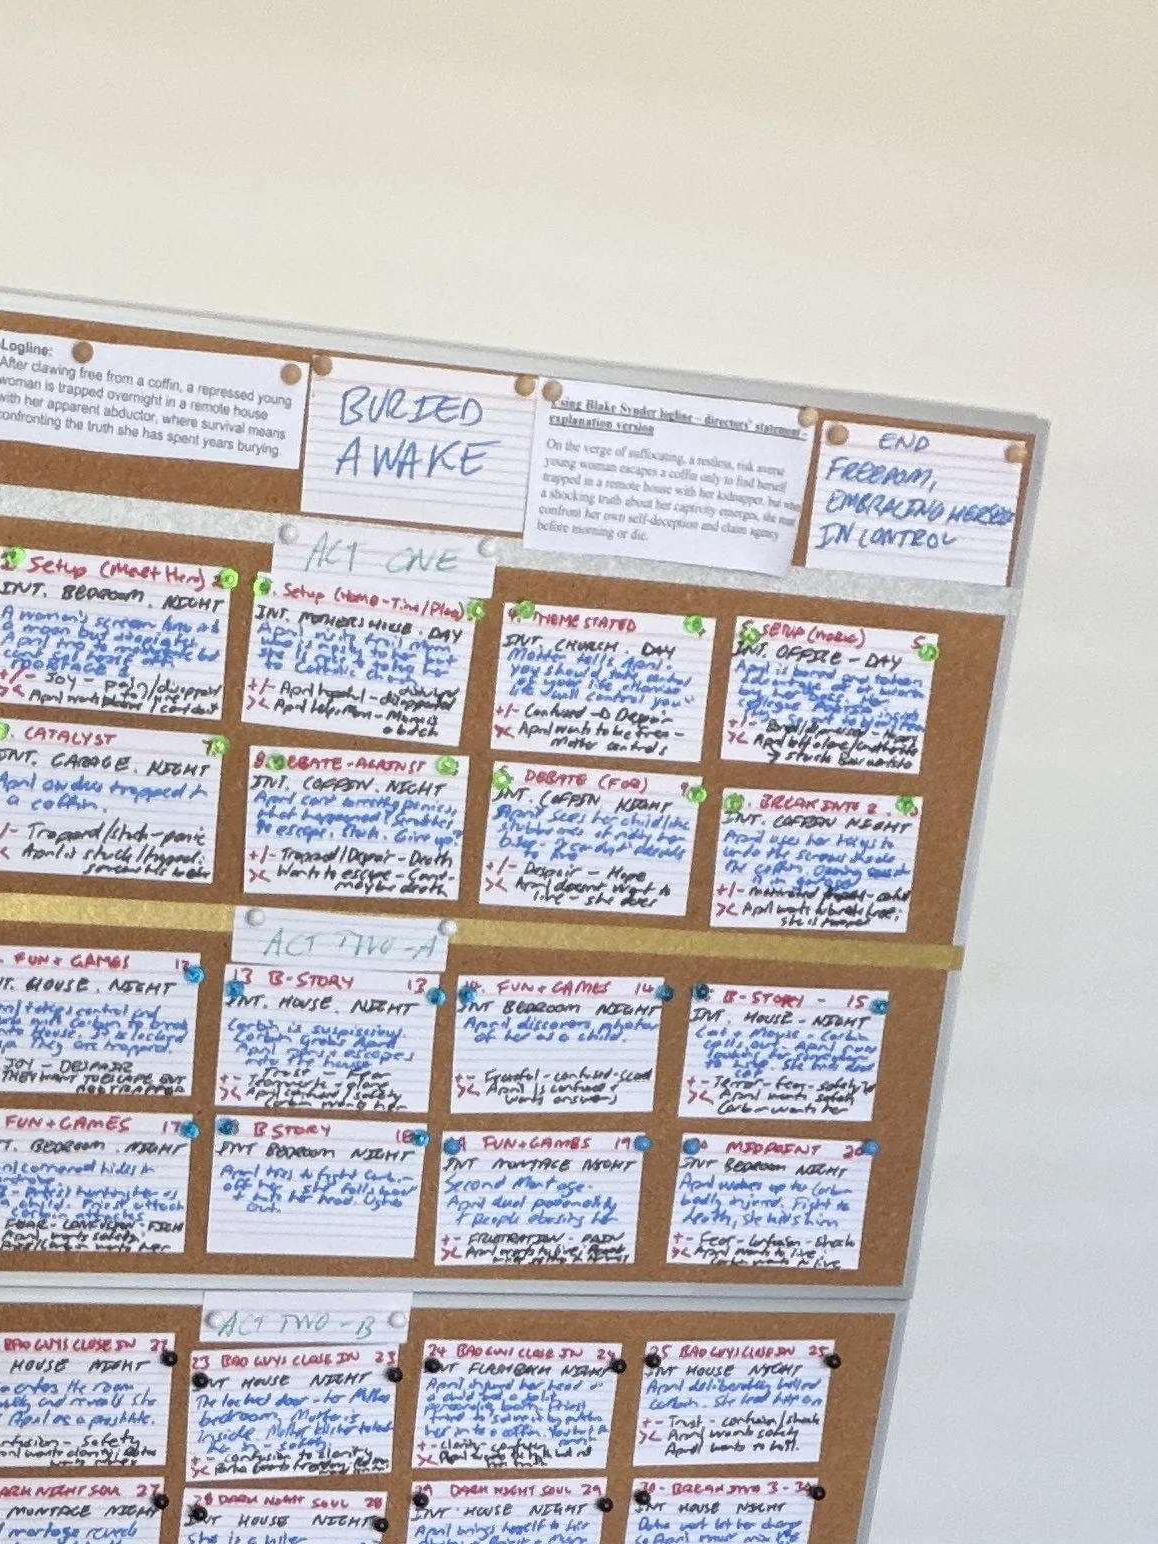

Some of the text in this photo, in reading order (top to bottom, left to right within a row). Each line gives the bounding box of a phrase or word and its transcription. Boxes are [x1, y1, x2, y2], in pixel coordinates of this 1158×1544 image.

[0, 356, 28, 371] After
[31, 360, 76, 380] clawing
[80, 365, 103, 381] free
[106, 369, 133, 385] from
[198, 384, 254, 403] repressed
[258, 393, 292, 409] young
[45, 381, 55, 392] is
[58, 382, 104, 400] trapped
[107, 389, 163, 409] overnight
[166, 396, 176, 408] in
[191, 400, 230, 415] remote
[233, 406, 269, 421] house
[339, 385, 483, 427] BURIED
[24, 394, 43, 407] her
[47, 399, 100, 417] apparent
[104, 405, 158, 424] abductor,
[163, 413, 198, 428] where
[201, 417, 245, 434] survival
[248, 426, 286, 441] means
[65, 417, 84, 431] the
[88, 420, 114, 435] truth
[117, 424, 139, 438] she
[143, 427, 164, 441] has
[167, 431, 200, 448] spent
[203, 436, 234, 452] years
[879, 432, 929, 452] END
[546, 438, 562, 450] On
[566, 440, 580, 452] the
[335, 436, 501, 480] AWAKE
[815, 521, 957, 549] IN CONTROL
[305, 531, 458, 574] ACT ONE
[583, 616, 637, 632] STATED
[428, 627, 462, 644] DAY
[641, 642, 676, 659] DAY
[865, 654, 902, 670] DAY
[24, 727, 117, 747] CATALYST
[524, 769, 587, 787] DEBATE
[263, 928, 315, 956] ACT
[70, 954, 131, 970] GAMES
[109, 979, 178, 995] NIGHT
[497, 980, 534, 996] FUN
[552, 980, 612, 996] GAMES
[279, 996, 333, 1013] HOUSE
[5, 1115, 132, 1133] FUN GAMES
[271, 1123, 331, 1139] STORY
